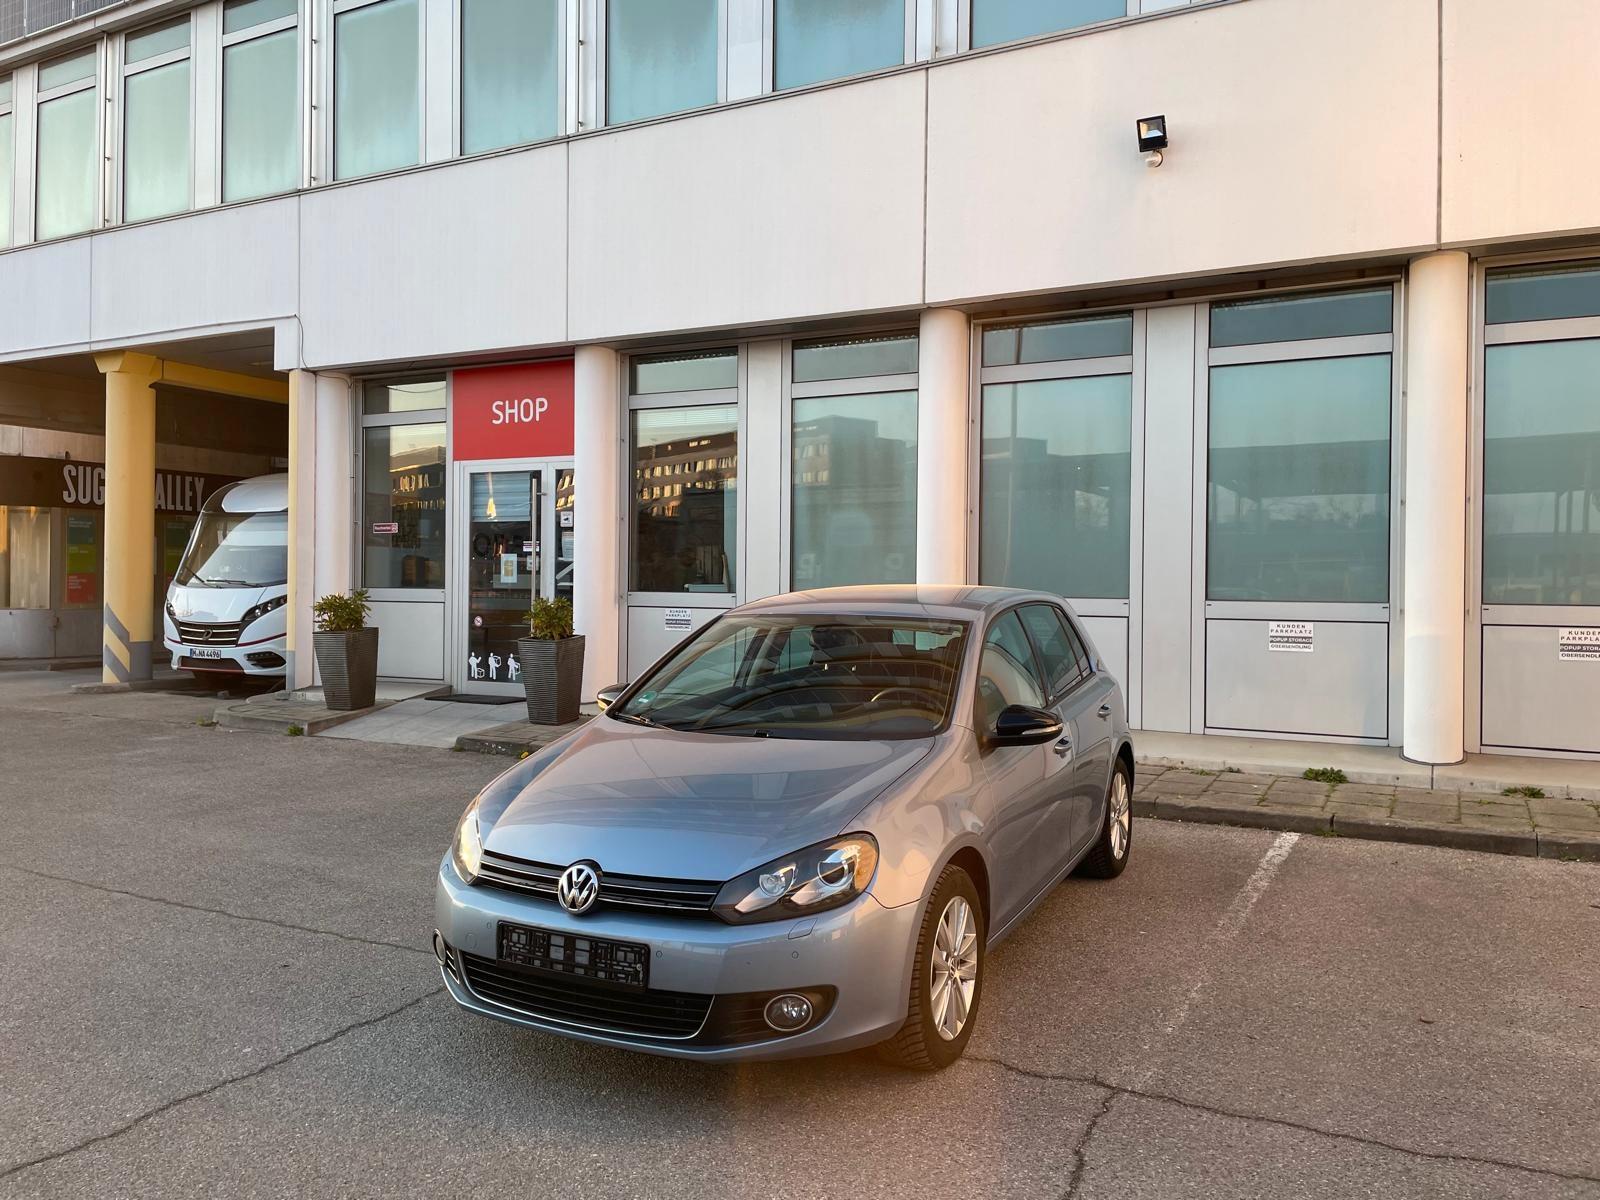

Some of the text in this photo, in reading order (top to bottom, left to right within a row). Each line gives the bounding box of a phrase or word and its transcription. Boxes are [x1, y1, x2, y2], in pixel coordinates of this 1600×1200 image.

[491, 397, 548, 425] SHOP
[63, 464, 205, 512] SUG ALLEY
[206, 650, 220, 658] 4496
